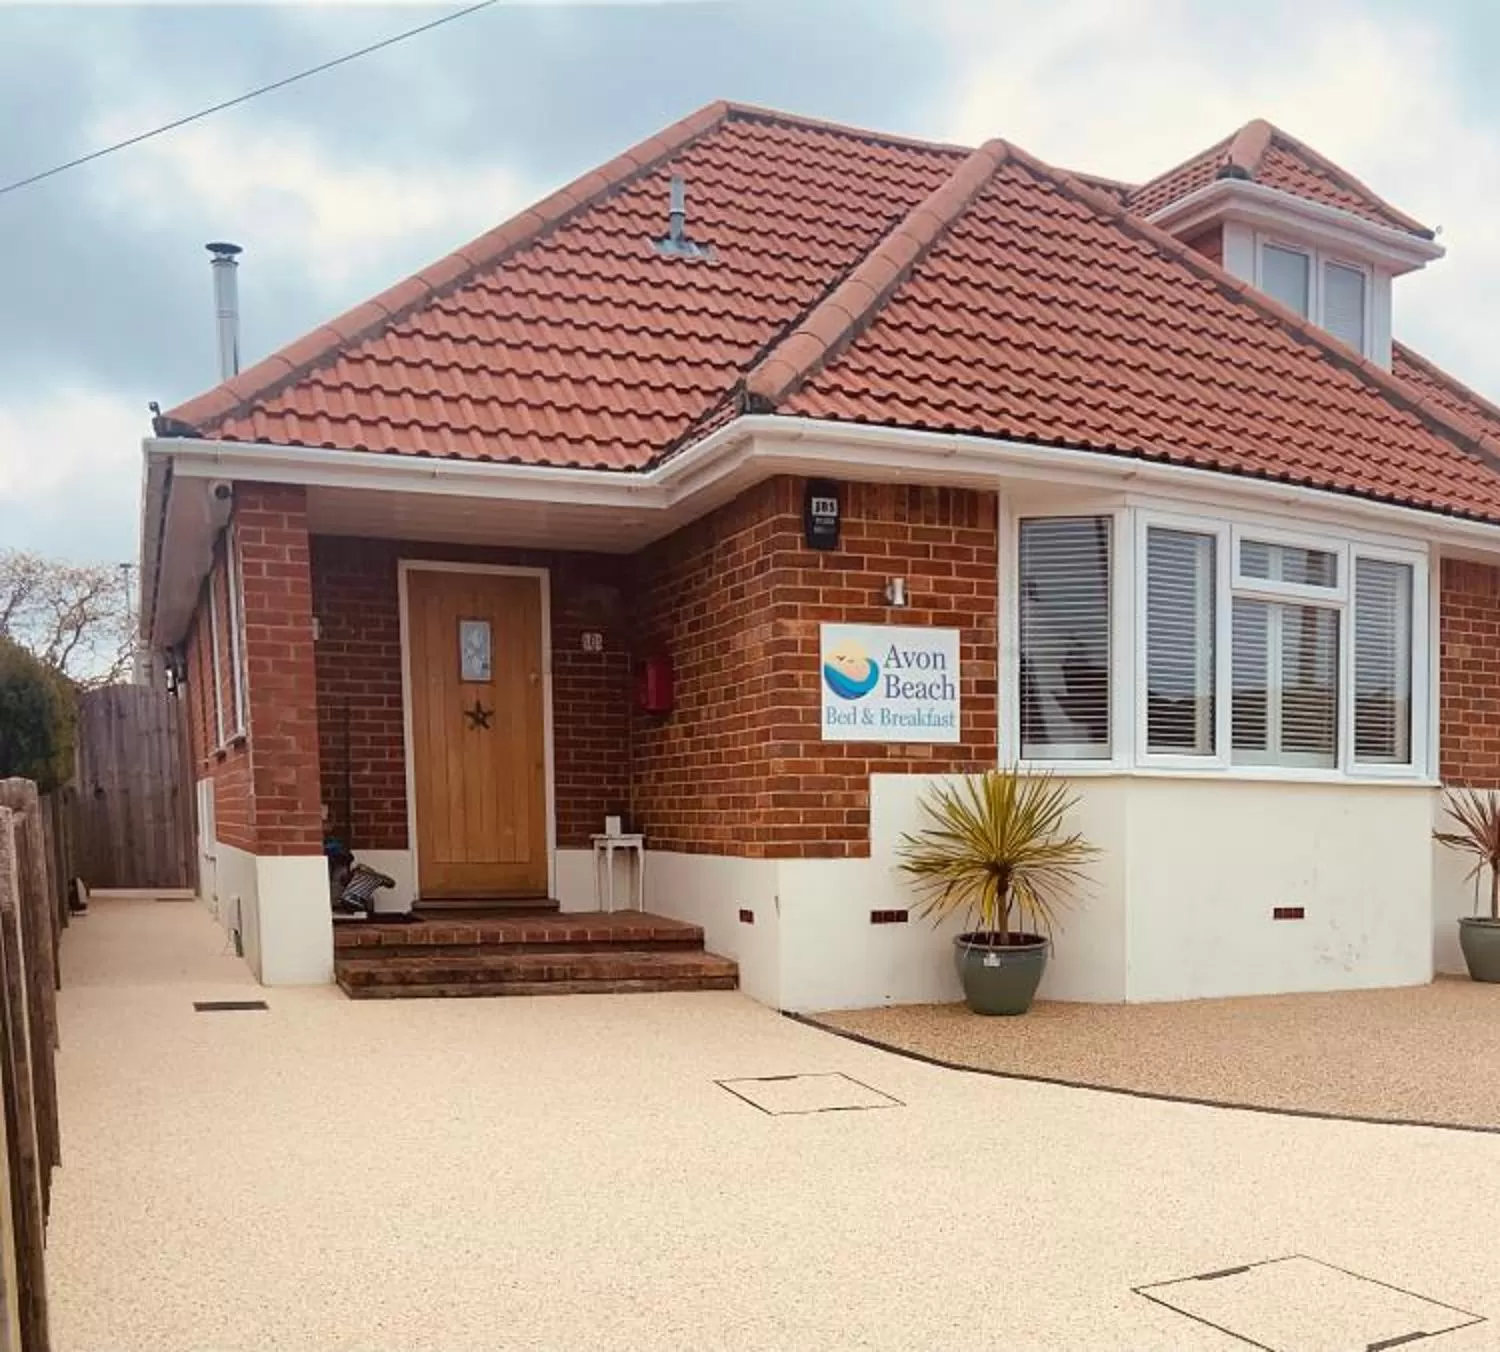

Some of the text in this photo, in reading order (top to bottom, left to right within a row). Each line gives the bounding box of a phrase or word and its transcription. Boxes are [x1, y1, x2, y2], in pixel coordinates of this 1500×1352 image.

[883, 643, 947, 671] Avon
[884, 674, 956, 701] Beach
[826, 705, 955, 728] Bed & Breakfast
